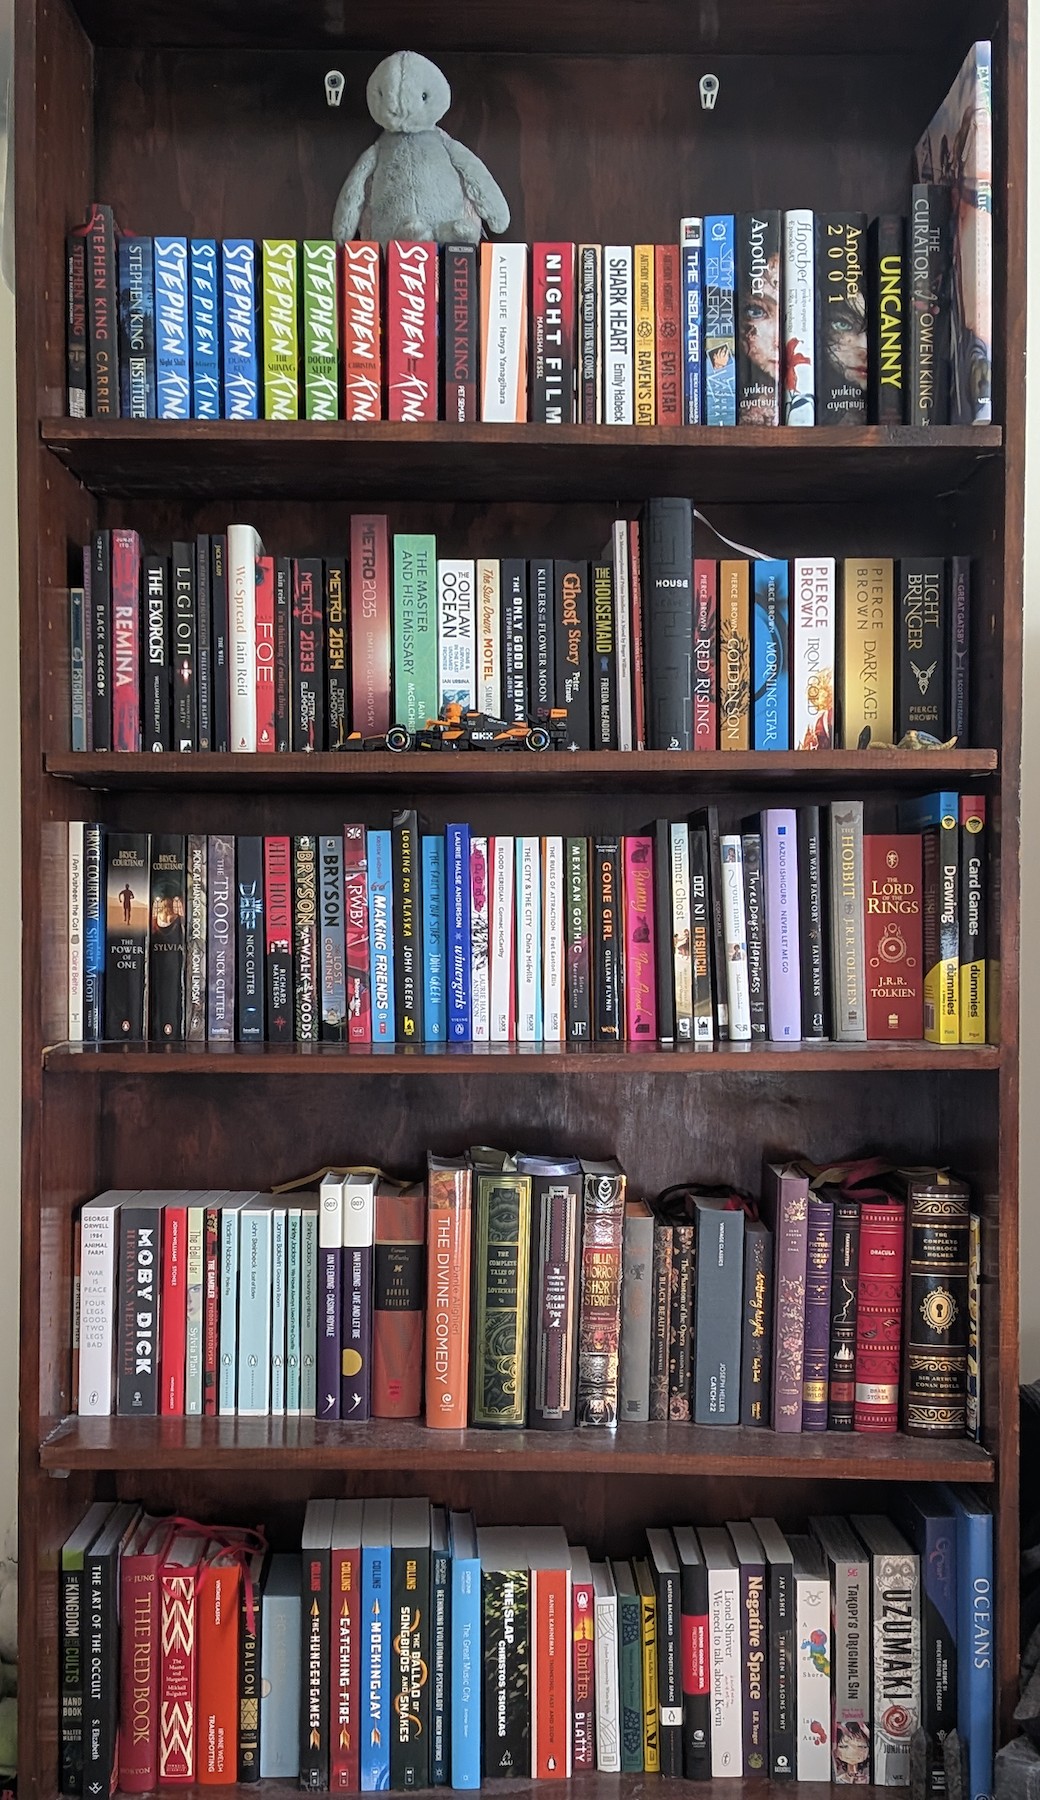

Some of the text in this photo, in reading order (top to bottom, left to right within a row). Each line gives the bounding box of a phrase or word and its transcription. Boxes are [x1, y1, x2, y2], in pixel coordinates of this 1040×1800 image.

[687, 252, 698, 283] THE
[748, 218, 769, 298] Another
[845, 224, 862, 300] Another
[913, 198, 930, 282] CURATOR
[154, 240, 187, 355] STEPHEN
[191, 244, 215, 355] STEPHEN
[222, 243, 254, 357] STEPHEN
[263, 240, 296, 355] STEPHEN
[303, 242, 337, 356] STEPHEN
[345, 243, 378, 358] STEPHEN
[394, 240, 428, 358] STEPHEN
[610, 258, 627, 354] SHARK HEART
[640, 254, 649, 312] ANTHONY HOROWITZ
[536, 316, 544, 378] MARISHA PESSL
[545, 254, 561, 423] NIGHT FILM
[880, 255, 902, 389] UNCANNY
[96, 351, 109, 413] CARRIE
[497, 327, 506, 404] Hanya Yanagihara
[919, 312, 937, 409] OWEN KING
[149, 567, 163, 666] THE EXORCIST
[442, 572, 456, 638] OCEAN
[458, 580, 470, 638] OUTLAW
[513, 597, 522, 629] ONLY
[537, 568, 546, 613] KILLERS
[562, 573, 581, 665] Ghost Story
[595, 579, 612, 653] HOUSEMAID
[801, 567, 813, 628] BROWN
[816, 567, 828, 627] PIERCE
[857, 568, 867, 630] BROWN
[872, 568, 883, 629] PIERCE
[904, 574, 922, 650] BRINGER
[924, 574, 939, 628] LIGHT
[116, 606, 132, 686] REMINA
[257, 623, 273, 682] FOE
[483, 638, 493, 680] MOTEL
[514, 635, 523, 669] GOOD
[538, 623, 547, 701] FLOWER MOON
[601, 678, 610, 742] FREIDA McFADDEN
[694, 638, 710, 734] RED RISING
[298, 850, 313, 925] BRYSON
[324, 855, 339, 927] BRYSON
[402, 830, 412, 937] LOOKING ALASKA
[572, 846, 582, 953] MEXICAN GOTHIC
[674, 838, 686, 920] Summer Ghost
[841, 835, 855, 899] HOBBIT
[941, 865, 956, 923] Drawing
[969, 858, 981, 935] Card Games
[213, 876, 229, 945] TROOP
[373, 894, 386, 950] MAKING
[602, 862, 612, 941] GONE GIRL
[867, 898, 919, 914] RINGS
[216, 950, 225, 975] NICK
[246, 935, 255, 995] NICK CUTTER
[375, 954, 388, 1009] FRIENDS
[404, 945, 413, 1009] JOHN GREEN
[451, 945, 466, 1009] wintergirls
[216, 978, 225, 1020] CUTTER
[189, 1230, 201, 1274] The Bell Jar
[207, 1260, 215, 1298] THE GAMBLER
[124, 1229, 135, 1375] HERMAN MELVILLE
[135, 1228, 153, 1375] MOBY DICK
[436, 1216, 451, 1384] THE DIVINE COMEDY
[680, 1273, 688, 1306] Phantom
[680, 1314, 688, 1323] the
[189, 1328, 199, 1377] Sylvia Plath
[678, 1325, 687, 1346] Opera
[709, 1376, 717, 1412] CATCH-22
[310, 1561, 321, 1591] COLLINS
[341, 1561, 351, 1591] COLLINS
[407, 1560, 416, 1589] COLLINS
[92, 1565, 101, 1699] THE ART OF THE OCCULT
[504, 1581, 514, 1643] THE SLAP
[724, 1590, 734, 1657] Lionel Shriver
[747, 1576, 763, 1699] Negative Space
[882, 1589, 912, 1699] UZUMAKI
[973, 1577, 991, 1669] OCEANS
[133, 1592, 151, 1745] THE RED BOOK
[310, 1636, 320, 1685] HUNGER
[339, 1618, 350, 1724] CATCHING FIRE
[370, 1622, 382, 1719] MOCKINGJAY
[400, 1606, 410, 1742] SONGBIRDS AND SNAKES
[498, 1640, 506, 1687] CHRISTOS
